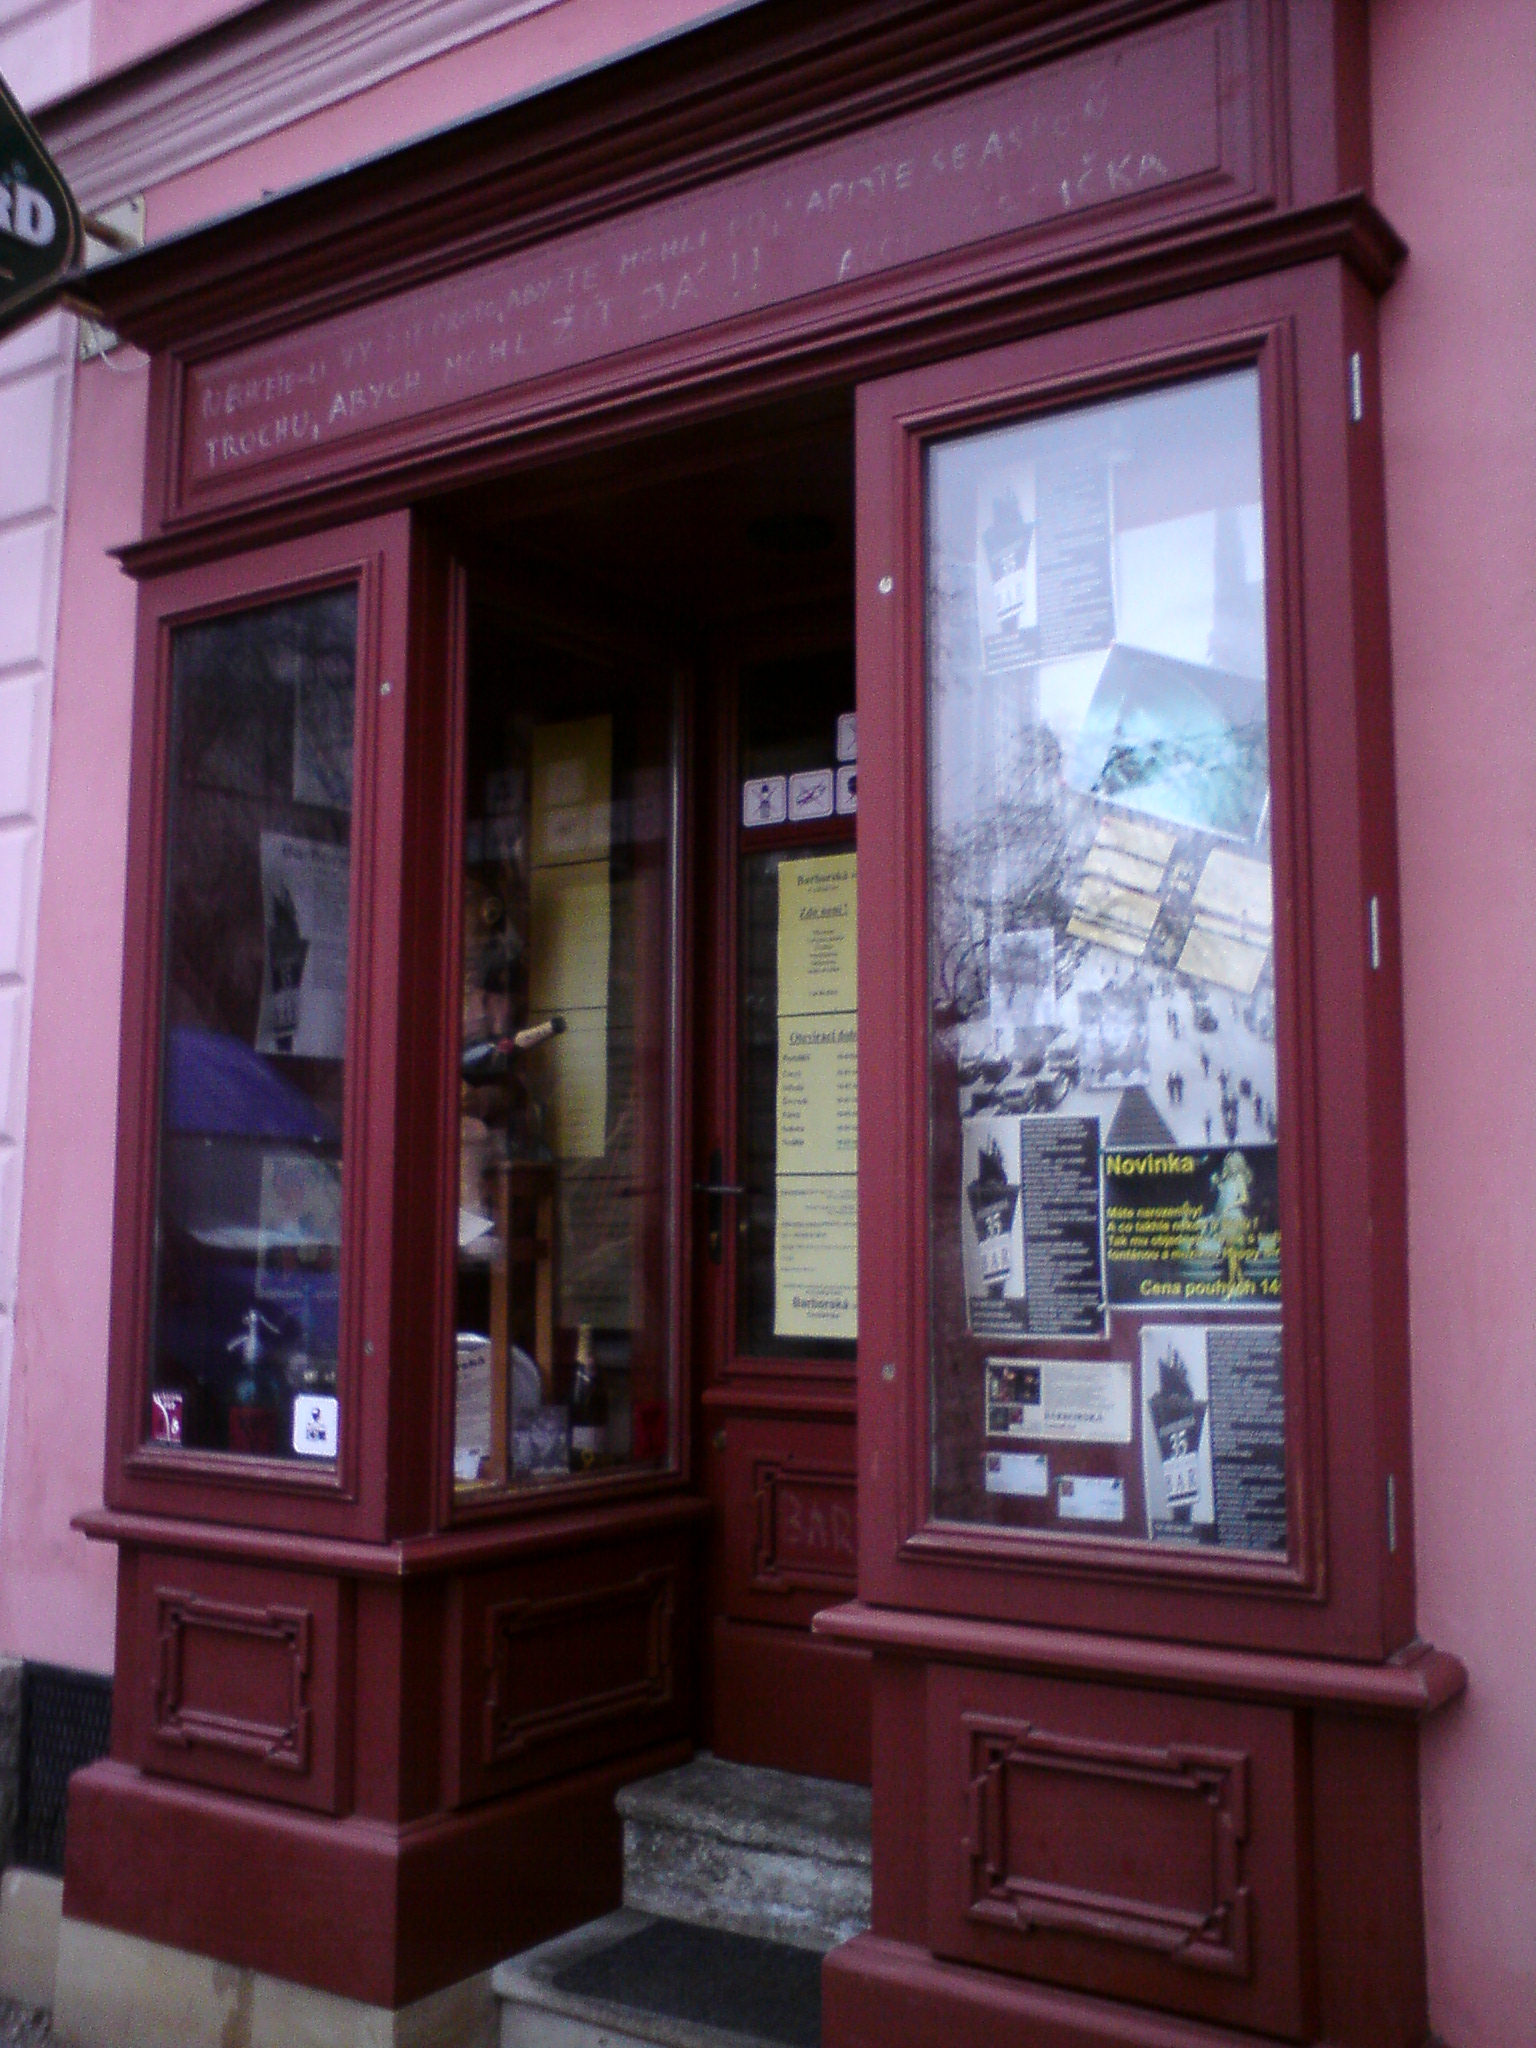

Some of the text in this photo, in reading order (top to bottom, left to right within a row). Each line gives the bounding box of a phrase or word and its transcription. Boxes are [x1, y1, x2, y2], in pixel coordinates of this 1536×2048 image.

[206, 408, 320, 468] TROCHU,
[329, 369, 421, 421] ABYCH
[1105, 1152, 1195, 1176] Novinka
[1139, 1278, 1182, 1295] Cena
